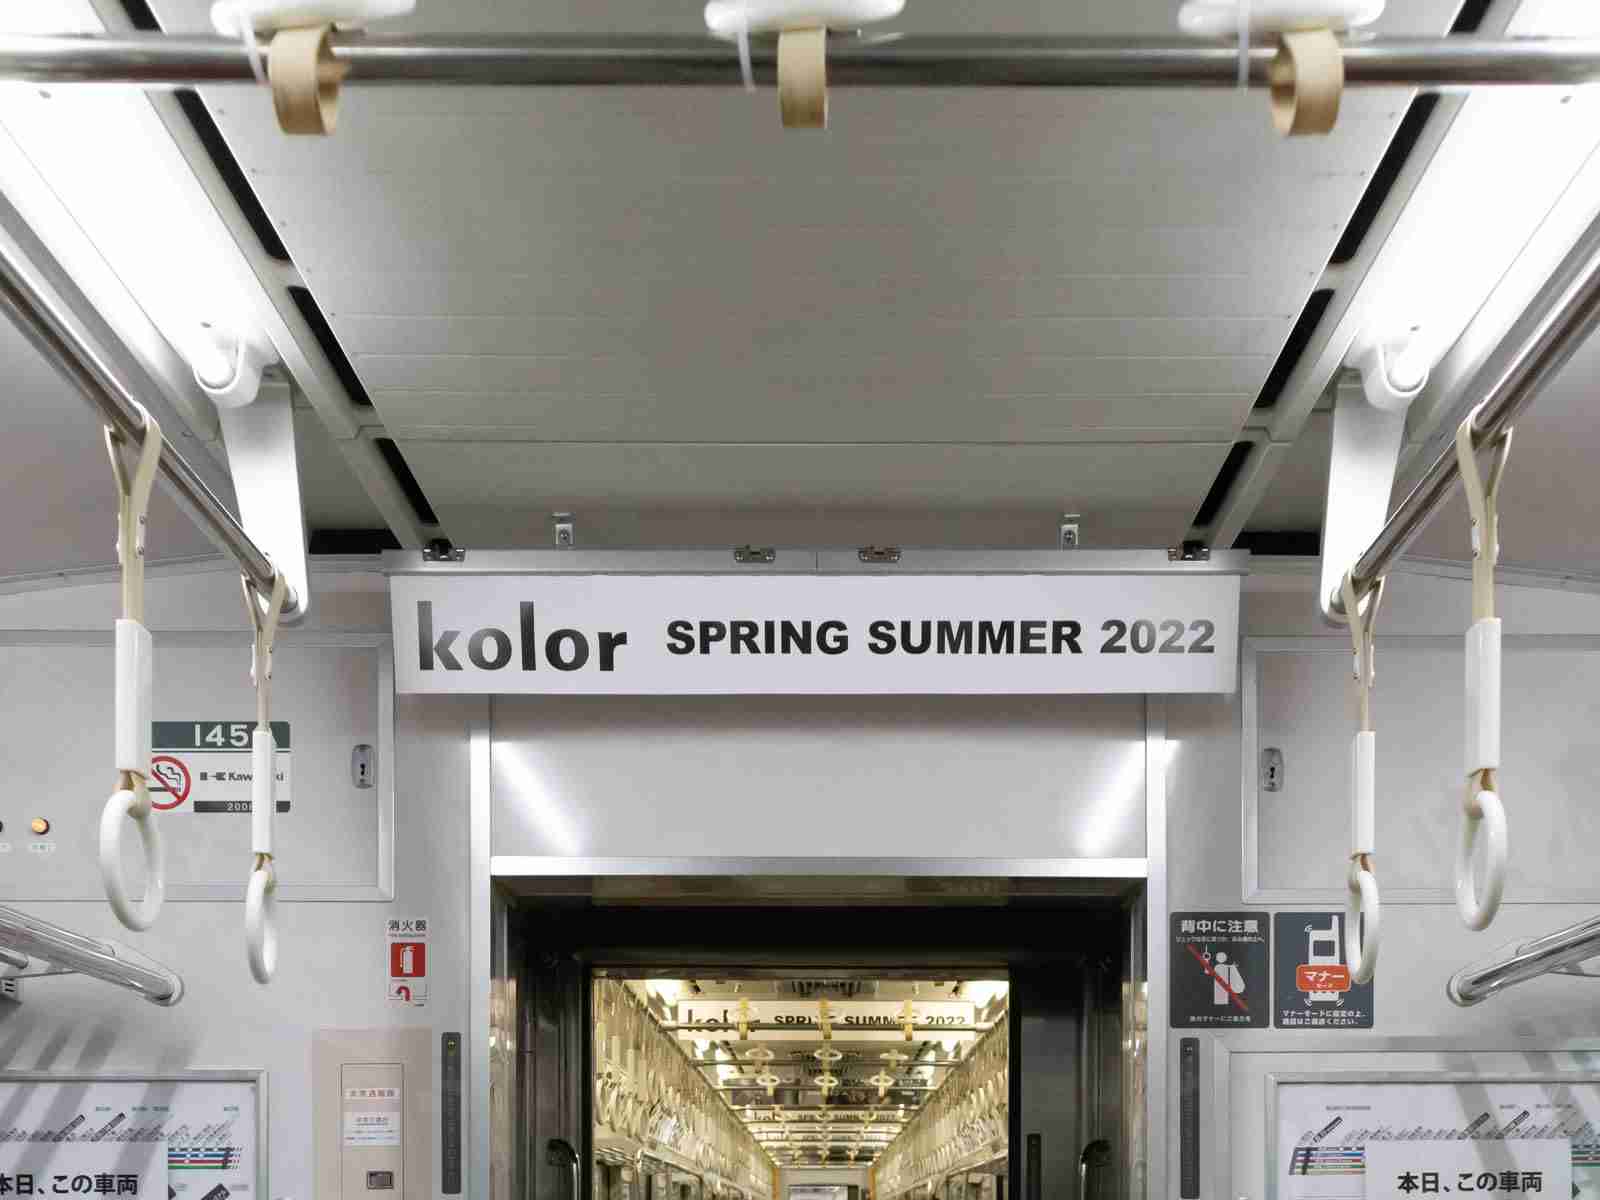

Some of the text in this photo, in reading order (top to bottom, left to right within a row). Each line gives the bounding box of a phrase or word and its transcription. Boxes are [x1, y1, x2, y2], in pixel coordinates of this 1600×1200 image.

[417, 600, 1217, 672] kolor SPRING SUMMER 2022
[194, 724, 279, 748] 145
[228, 772, 285, 781] Kawki
[226, 802, 252, 812] 200
[844, 1015, 918, 1028] SUMM
[0, 1173, 139, 1197] 本日、この車両
[1396, 1170, 1543, 1194] 本日、この車両
